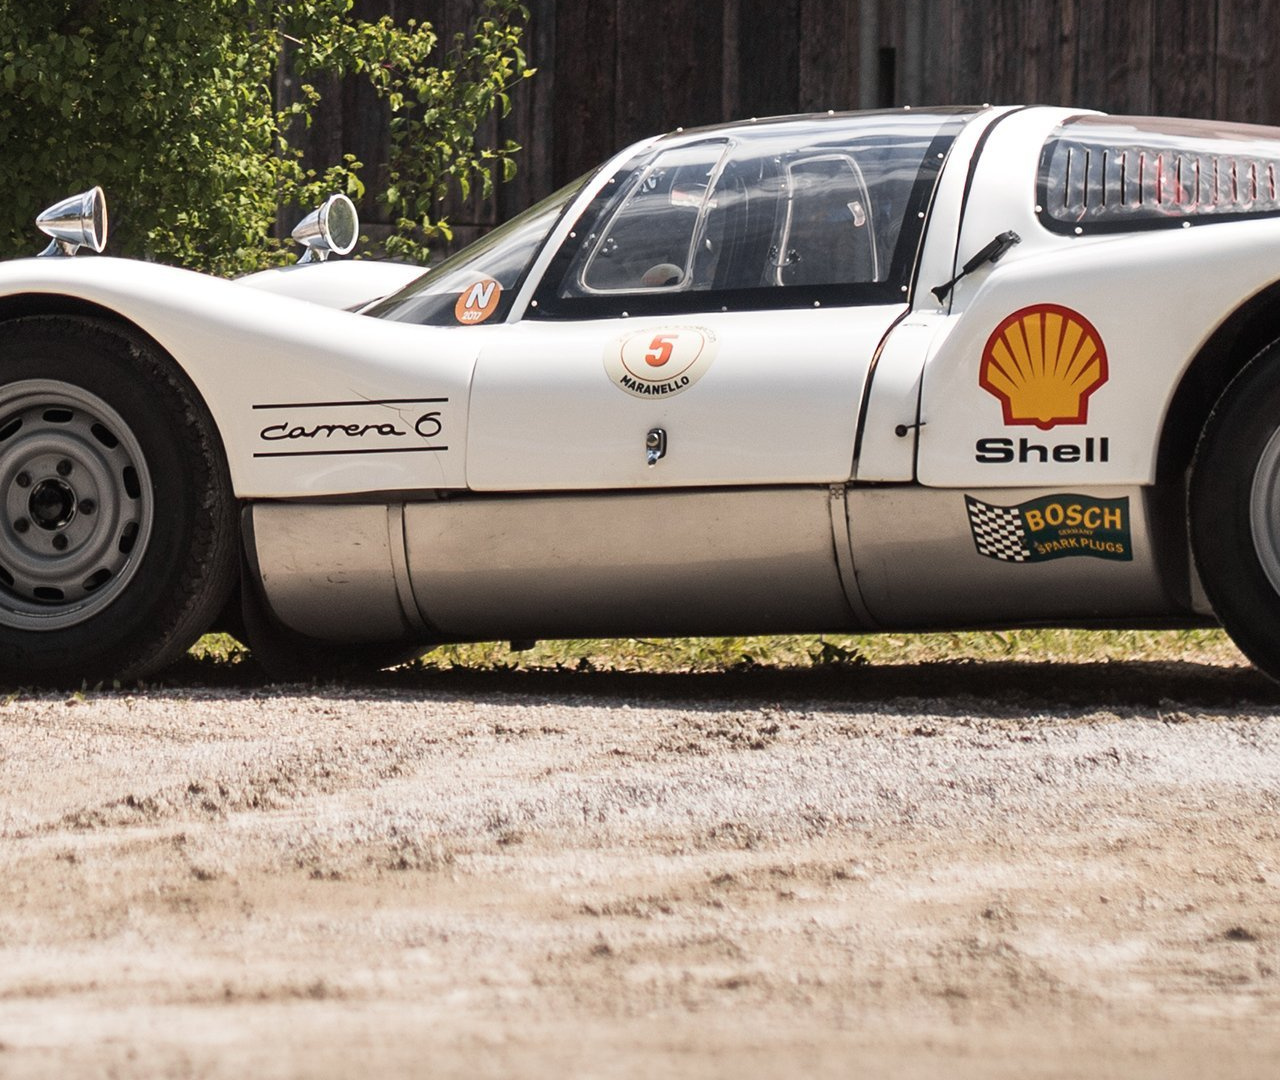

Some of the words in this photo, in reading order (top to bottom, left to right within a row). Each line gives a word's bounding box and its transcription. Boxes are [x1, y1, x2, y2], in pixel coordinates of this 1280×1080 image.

[465, 281, 496, 309] N
[644, 334, 679, 368] 5
[620, 374, 690, 395] MARANELLO
[414, 411, 442, 438] 6
[974, 437, 1109, 464] Shell
[1024, 503, 1122, 532] BOSCH
[1037, 537, 1079, 555] SPARK
[1080, 537, 1125, 554] PLUGS
